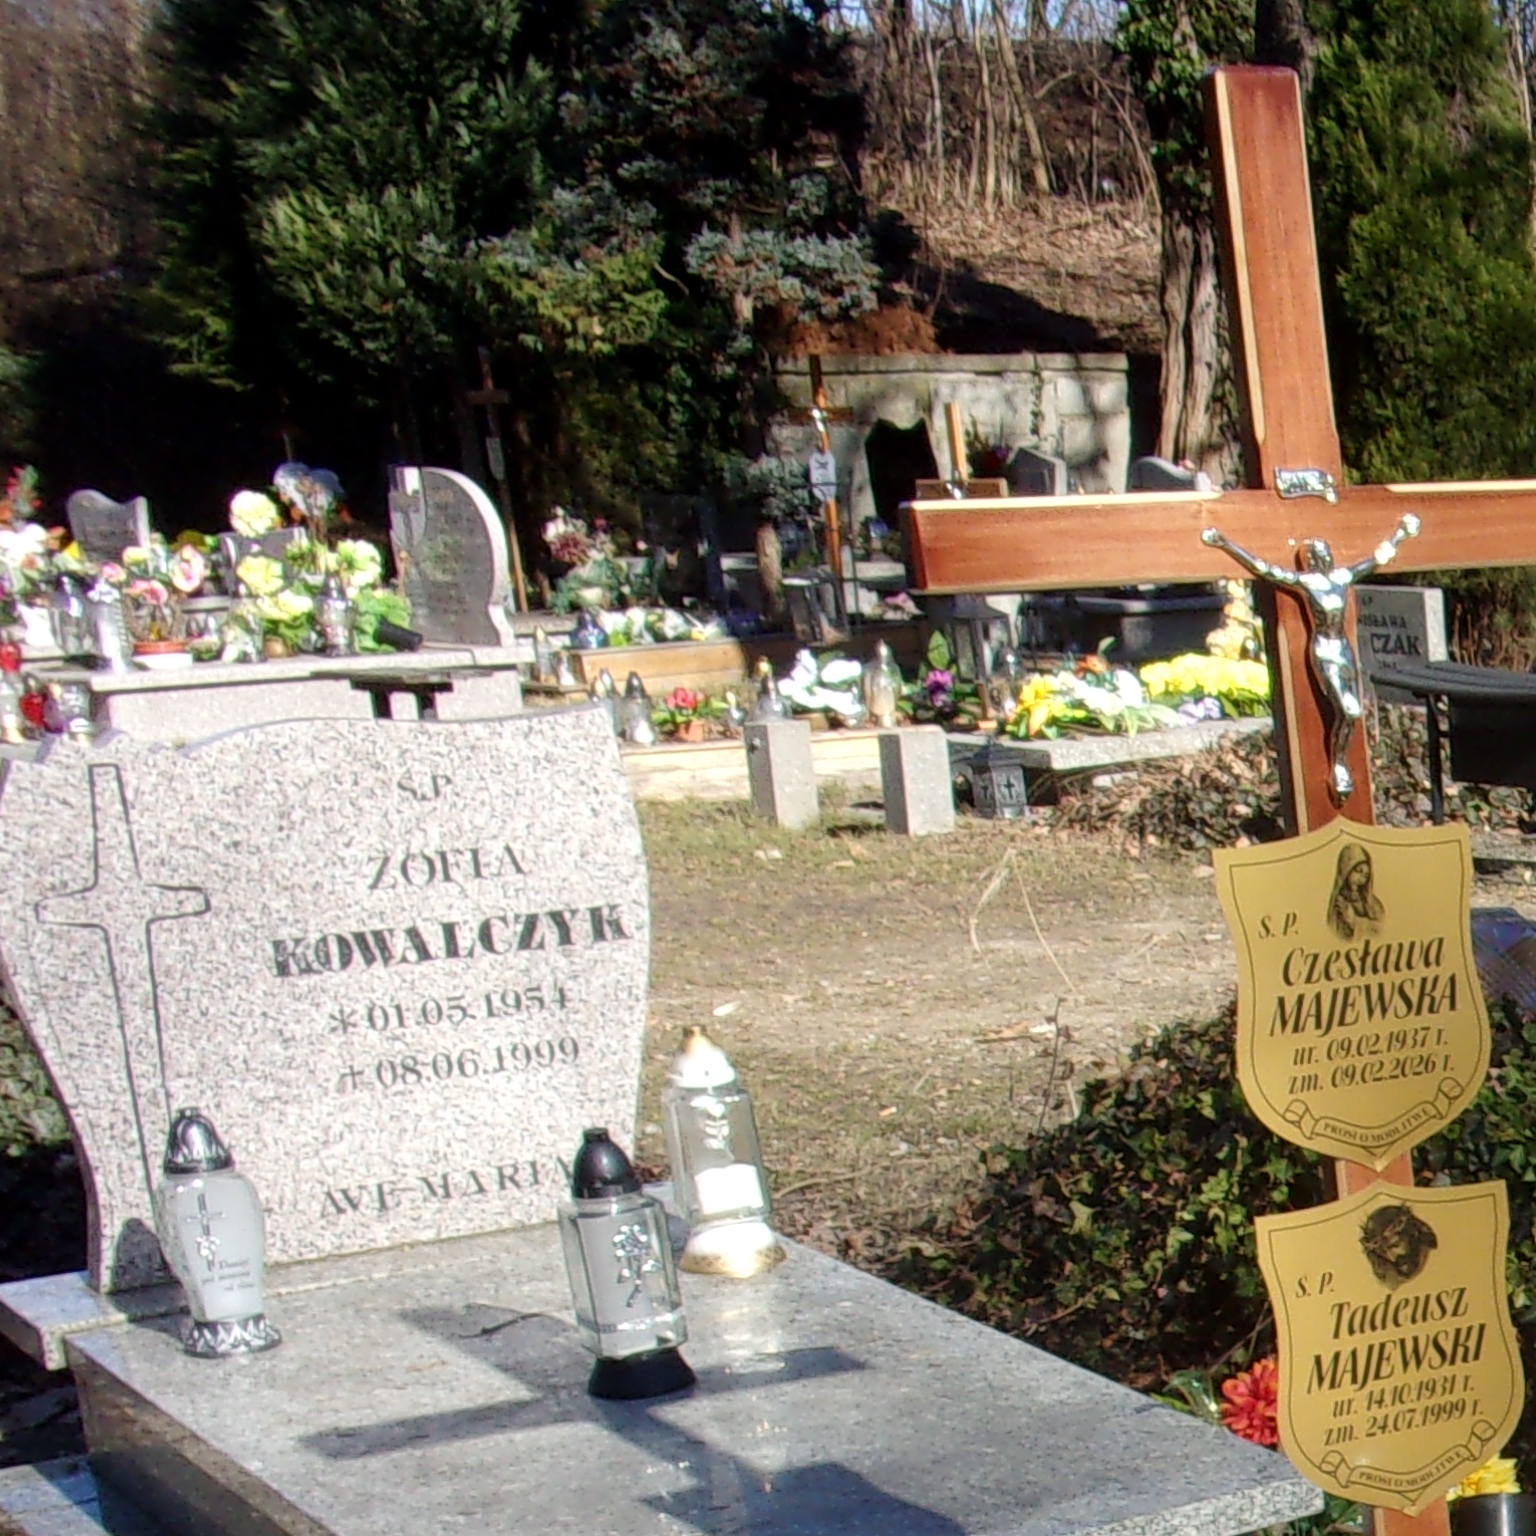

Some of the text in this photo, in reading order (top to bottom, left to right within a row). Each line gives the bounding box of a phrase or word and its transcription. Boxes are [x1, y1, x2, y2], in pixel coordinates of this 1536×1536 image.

[367, 844, 527, 890] ZOFIA
[270, 903, 634, 978] KOWALCZYK
[1282, 936, 1445, 987] Czesława
[1269, 972, 1458, 1038] MAJEWSKA
[375, 1036, 581, 1090] 08.06.1999
[1293, 1026, 1449, 1066] ur. 09.02.1937 r.
[1288, 1054, 1455, 1095] zm. 09.02.2026 r.
[1329, 1287, 1469, 1340] Tadeusz
[1307, 1323, 1487, 1395] MAJEWSKI
[1332, 1374, 1475, 1419] ur. 14.10.1931 r.
[1323, 1399, 1485, 1447] zm. 24.07.1999 r.
